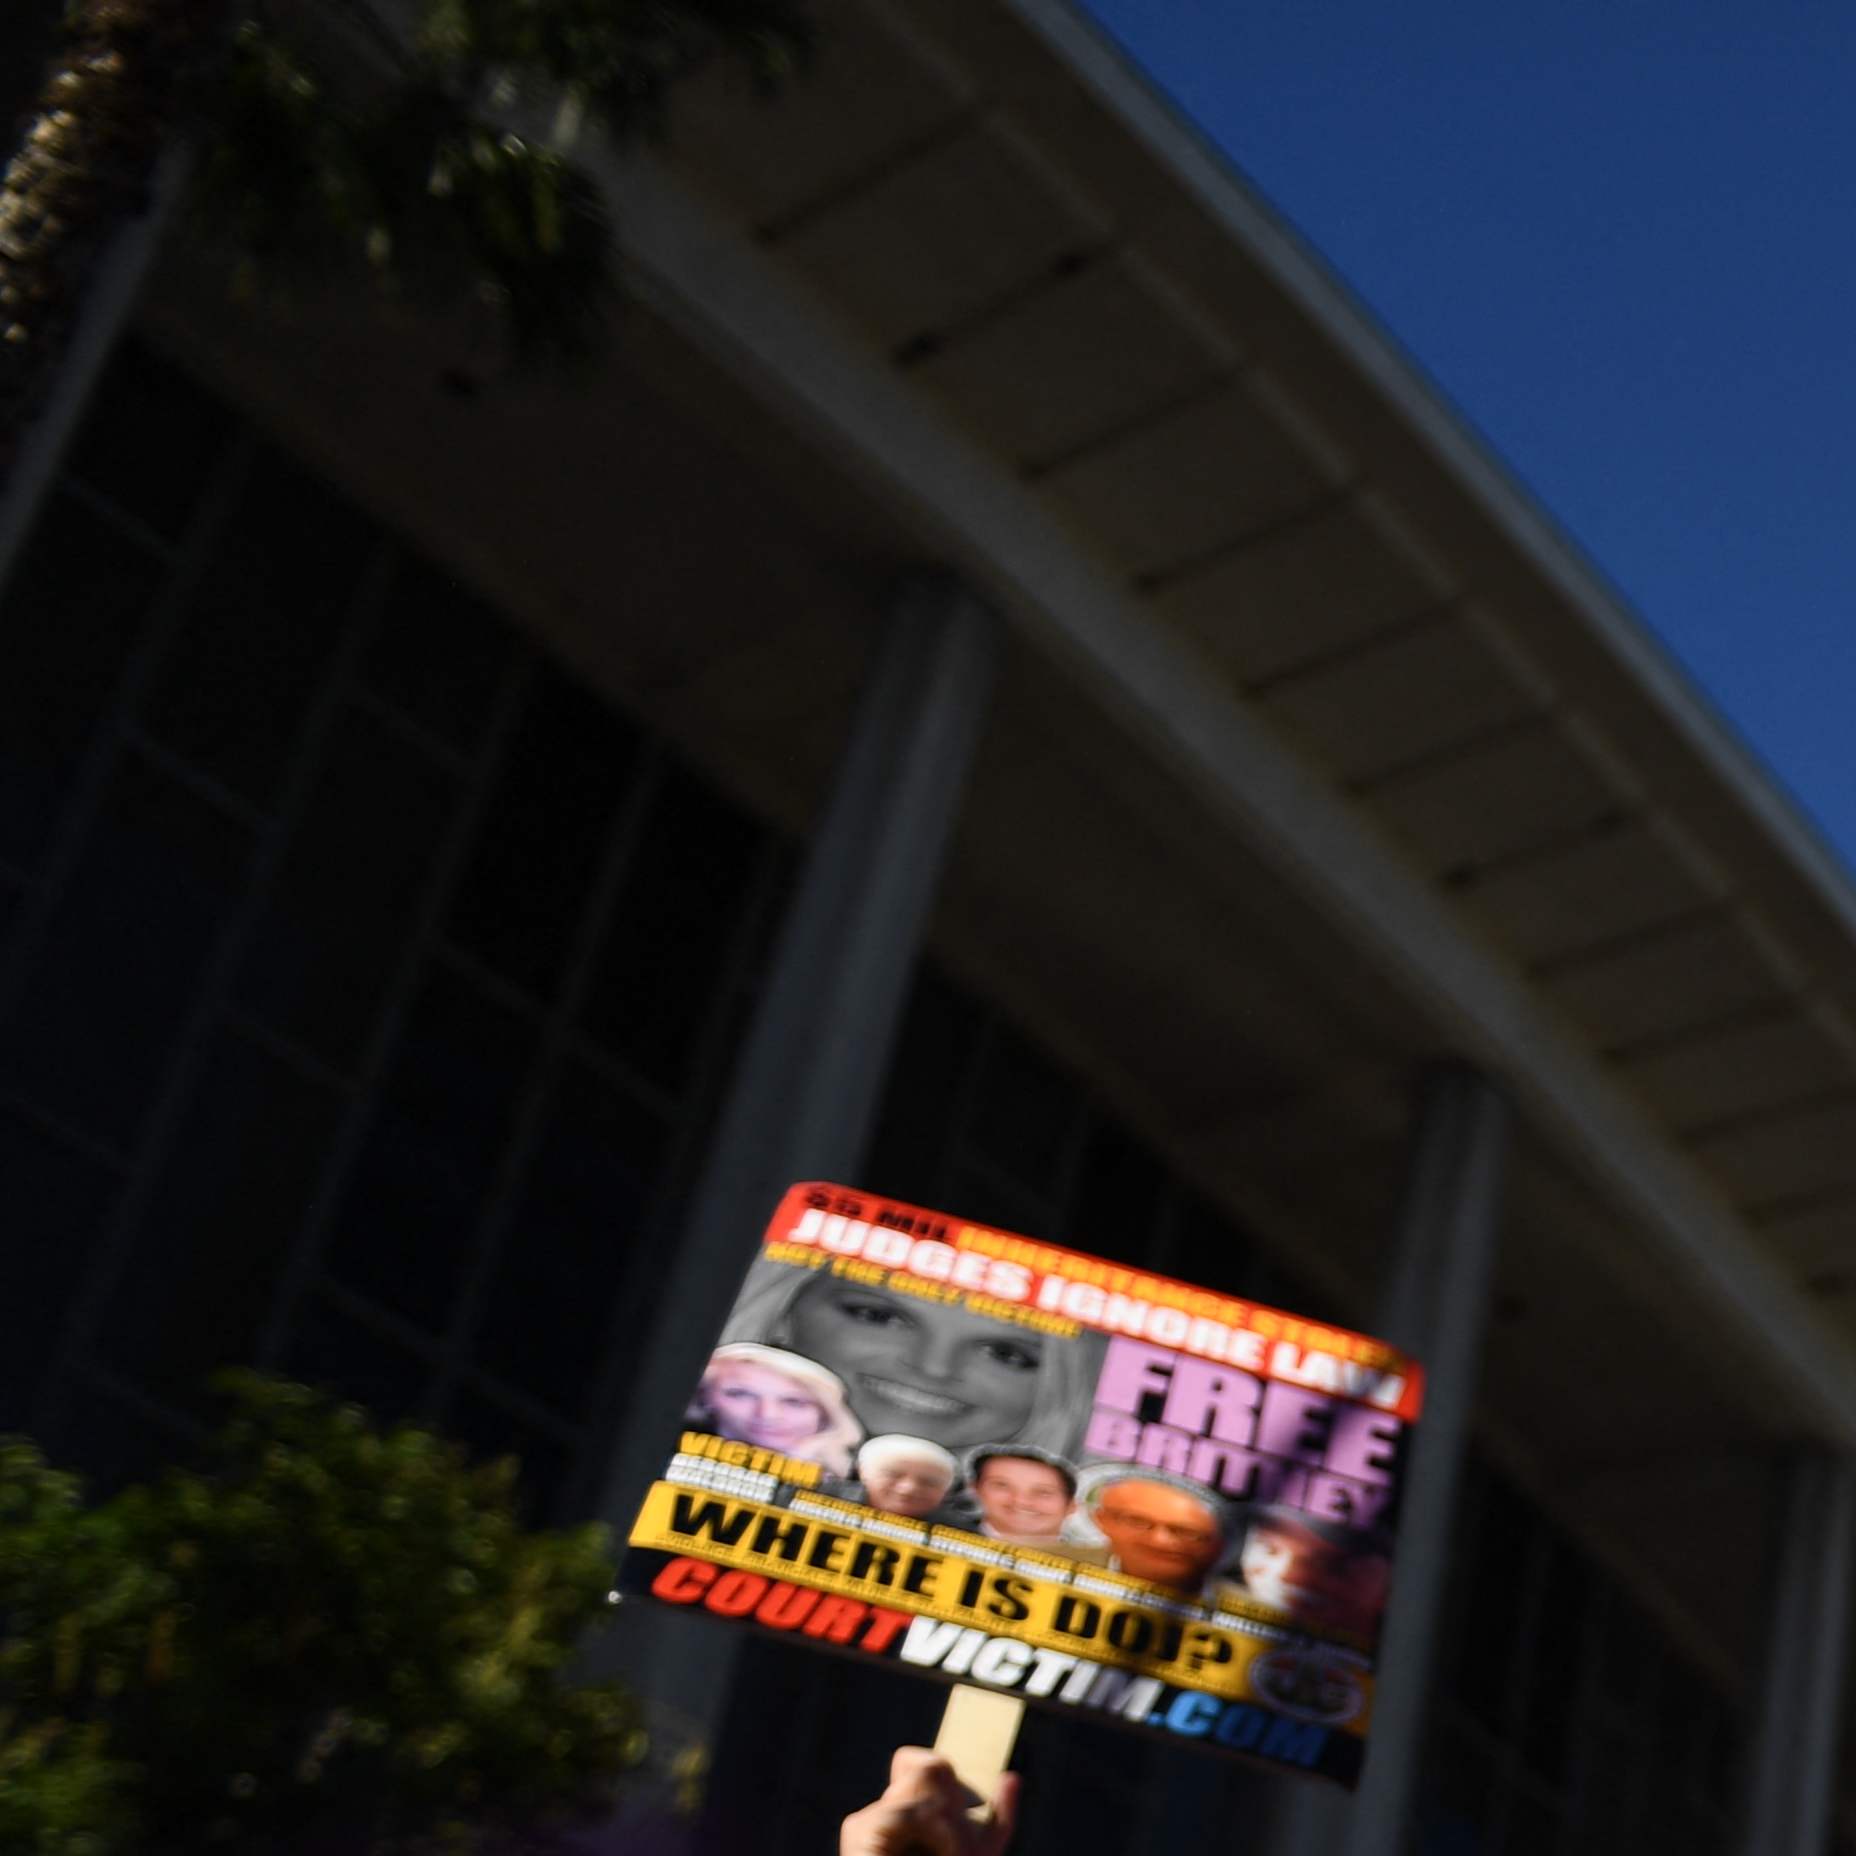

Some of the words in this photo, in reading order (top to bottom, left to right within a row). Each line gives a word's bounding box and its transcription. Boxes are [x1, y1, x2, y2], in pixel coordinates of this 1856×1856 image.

[788, 1207, 1035, 1302] JUDGES
[1035, 1272, 1269, 1372] IGNORE
[1269, 1339, 1407, 1410] LAW
[679, 1430, 823, 1488] VICTIM
[1082, 1402, 1392, 1529] BRITNEY
[1092, 1332, 1404, 1489] FREE
[651, 1555, 1329, 1767] COURTVICTIM.COM
[669, 1493, 945, 1598] WHERE
[956, 1569, 1030, 1621] IS
[1051, 1595, 1235, 1673] DOJ?
